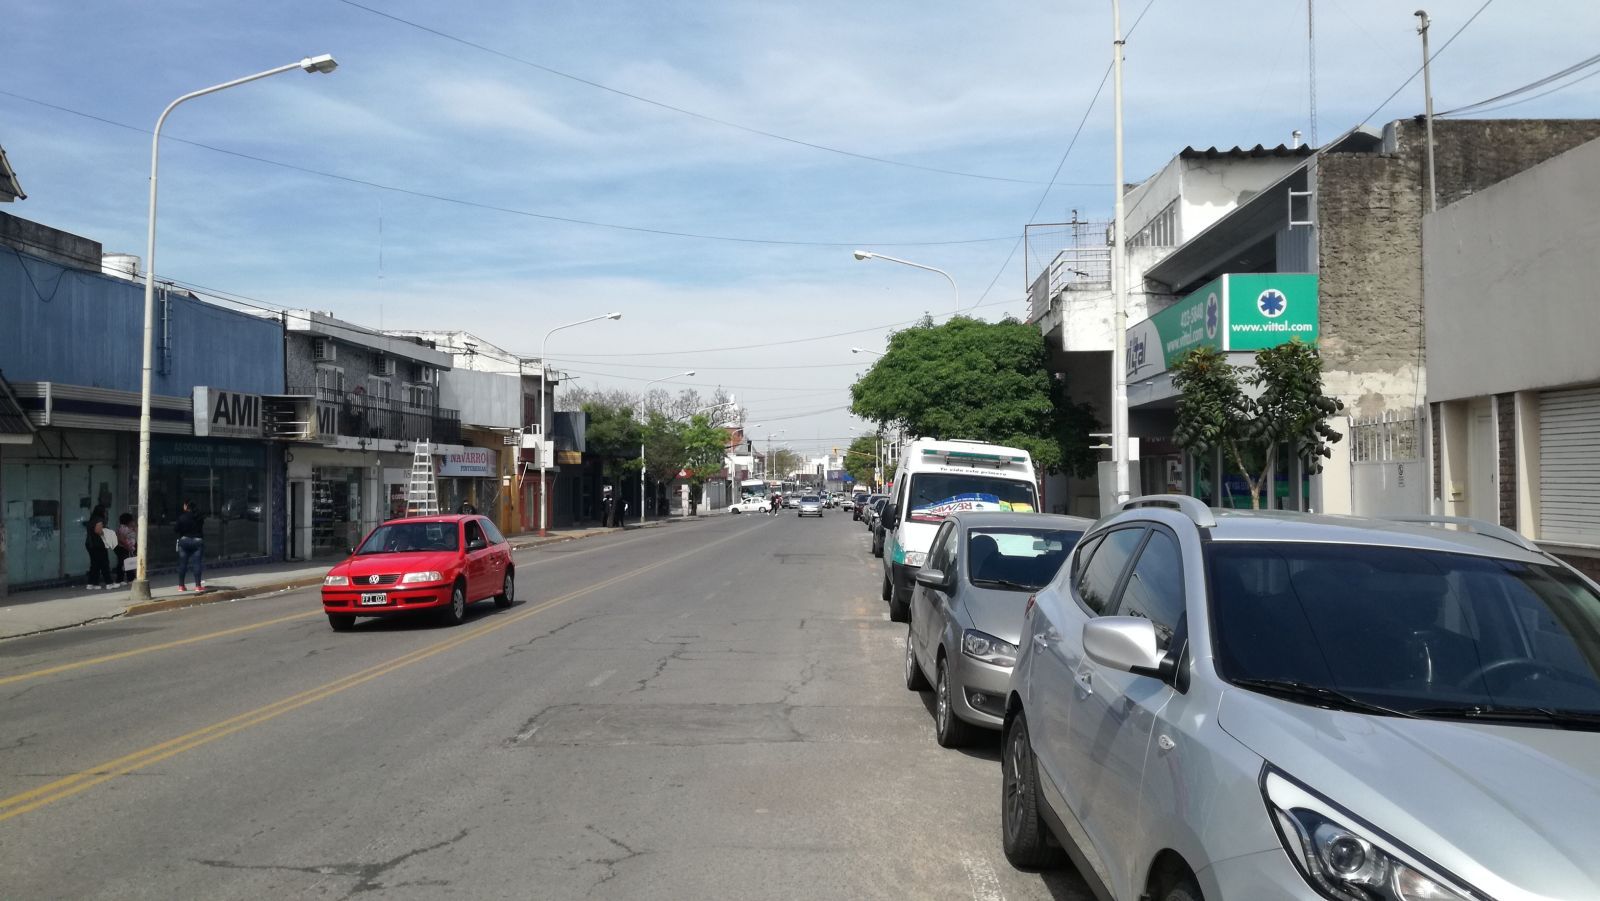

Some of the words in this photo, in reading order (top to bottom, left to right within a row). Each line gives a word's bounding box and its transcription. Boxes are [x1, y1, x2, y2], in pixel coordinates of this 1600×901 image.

[1231, 320, 1313, 332] www.vittal.com
[212, 391, 259, 427] AMI
[450, 452, 486, 464] NAVARRO
